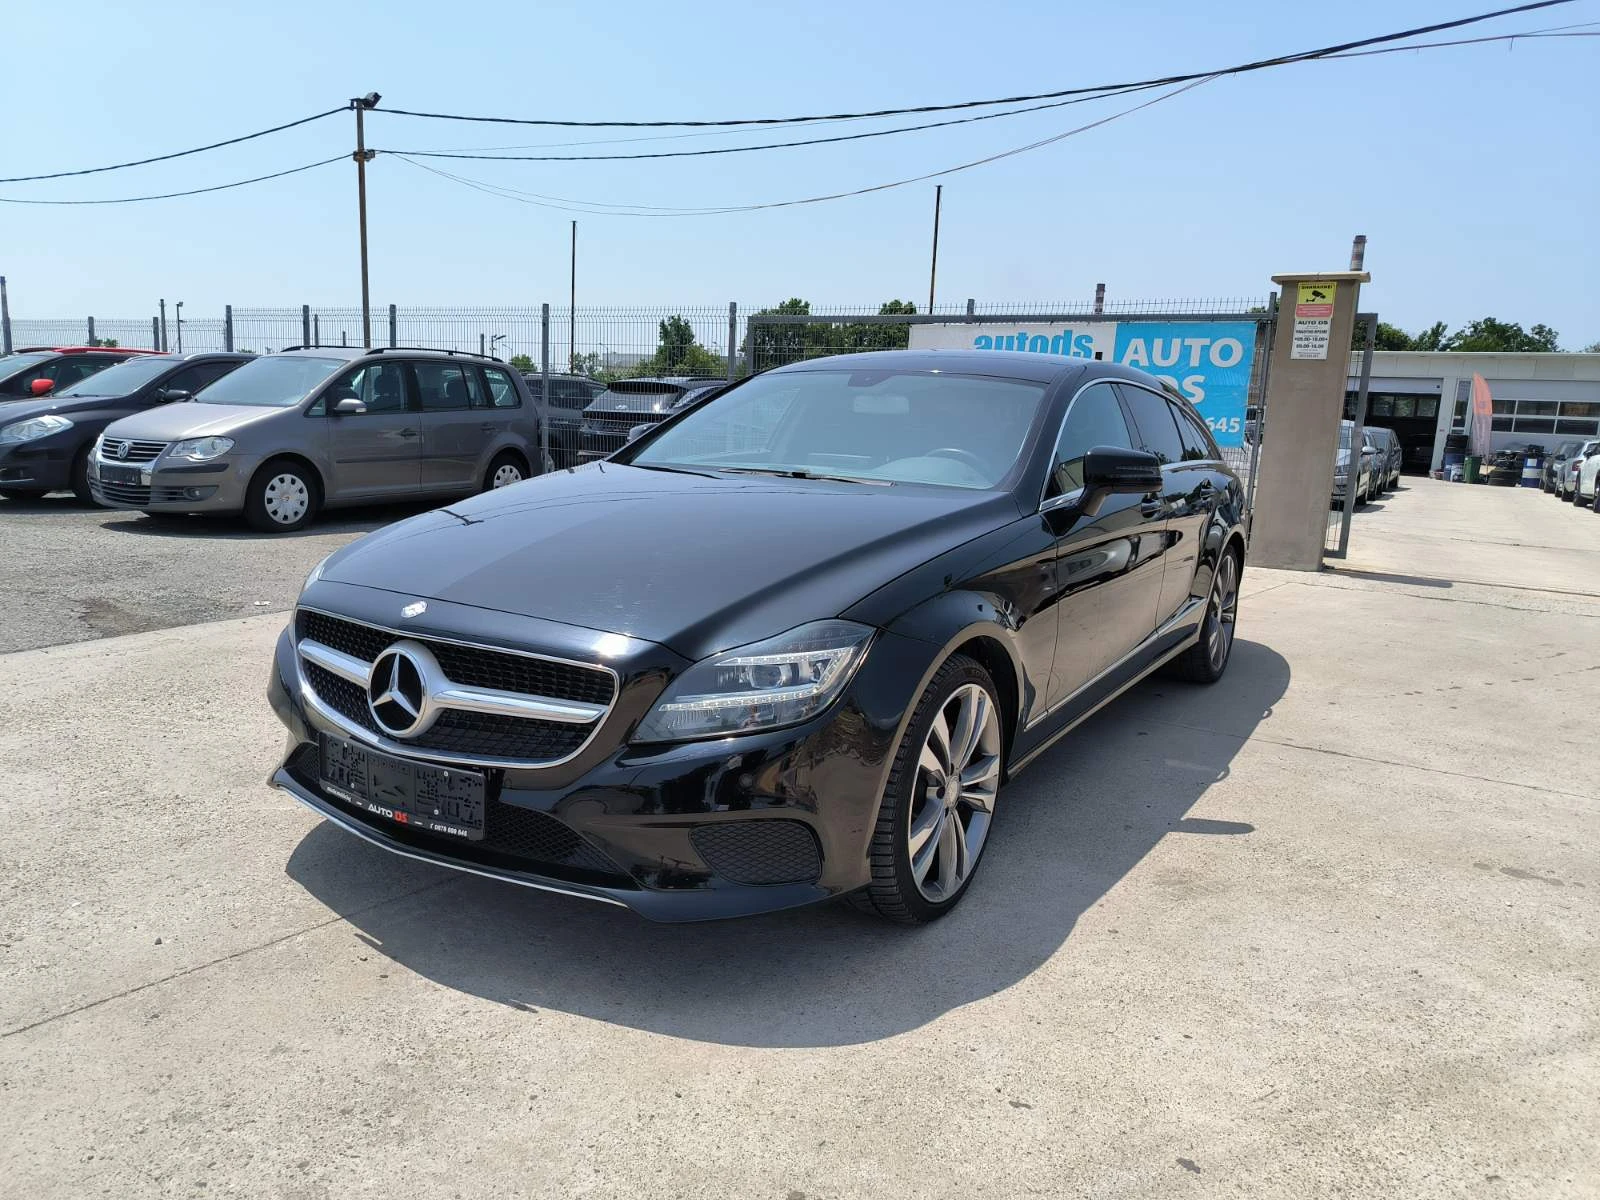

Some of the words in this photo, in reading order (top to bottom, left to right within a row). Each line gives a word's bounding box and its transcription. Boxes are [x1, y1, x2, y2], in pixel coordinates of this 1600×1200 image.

[1121, 337, 1243, 368] AUTO
[367, 803, 393, 818] AUTO
[394, 810, 408, 823] DS
